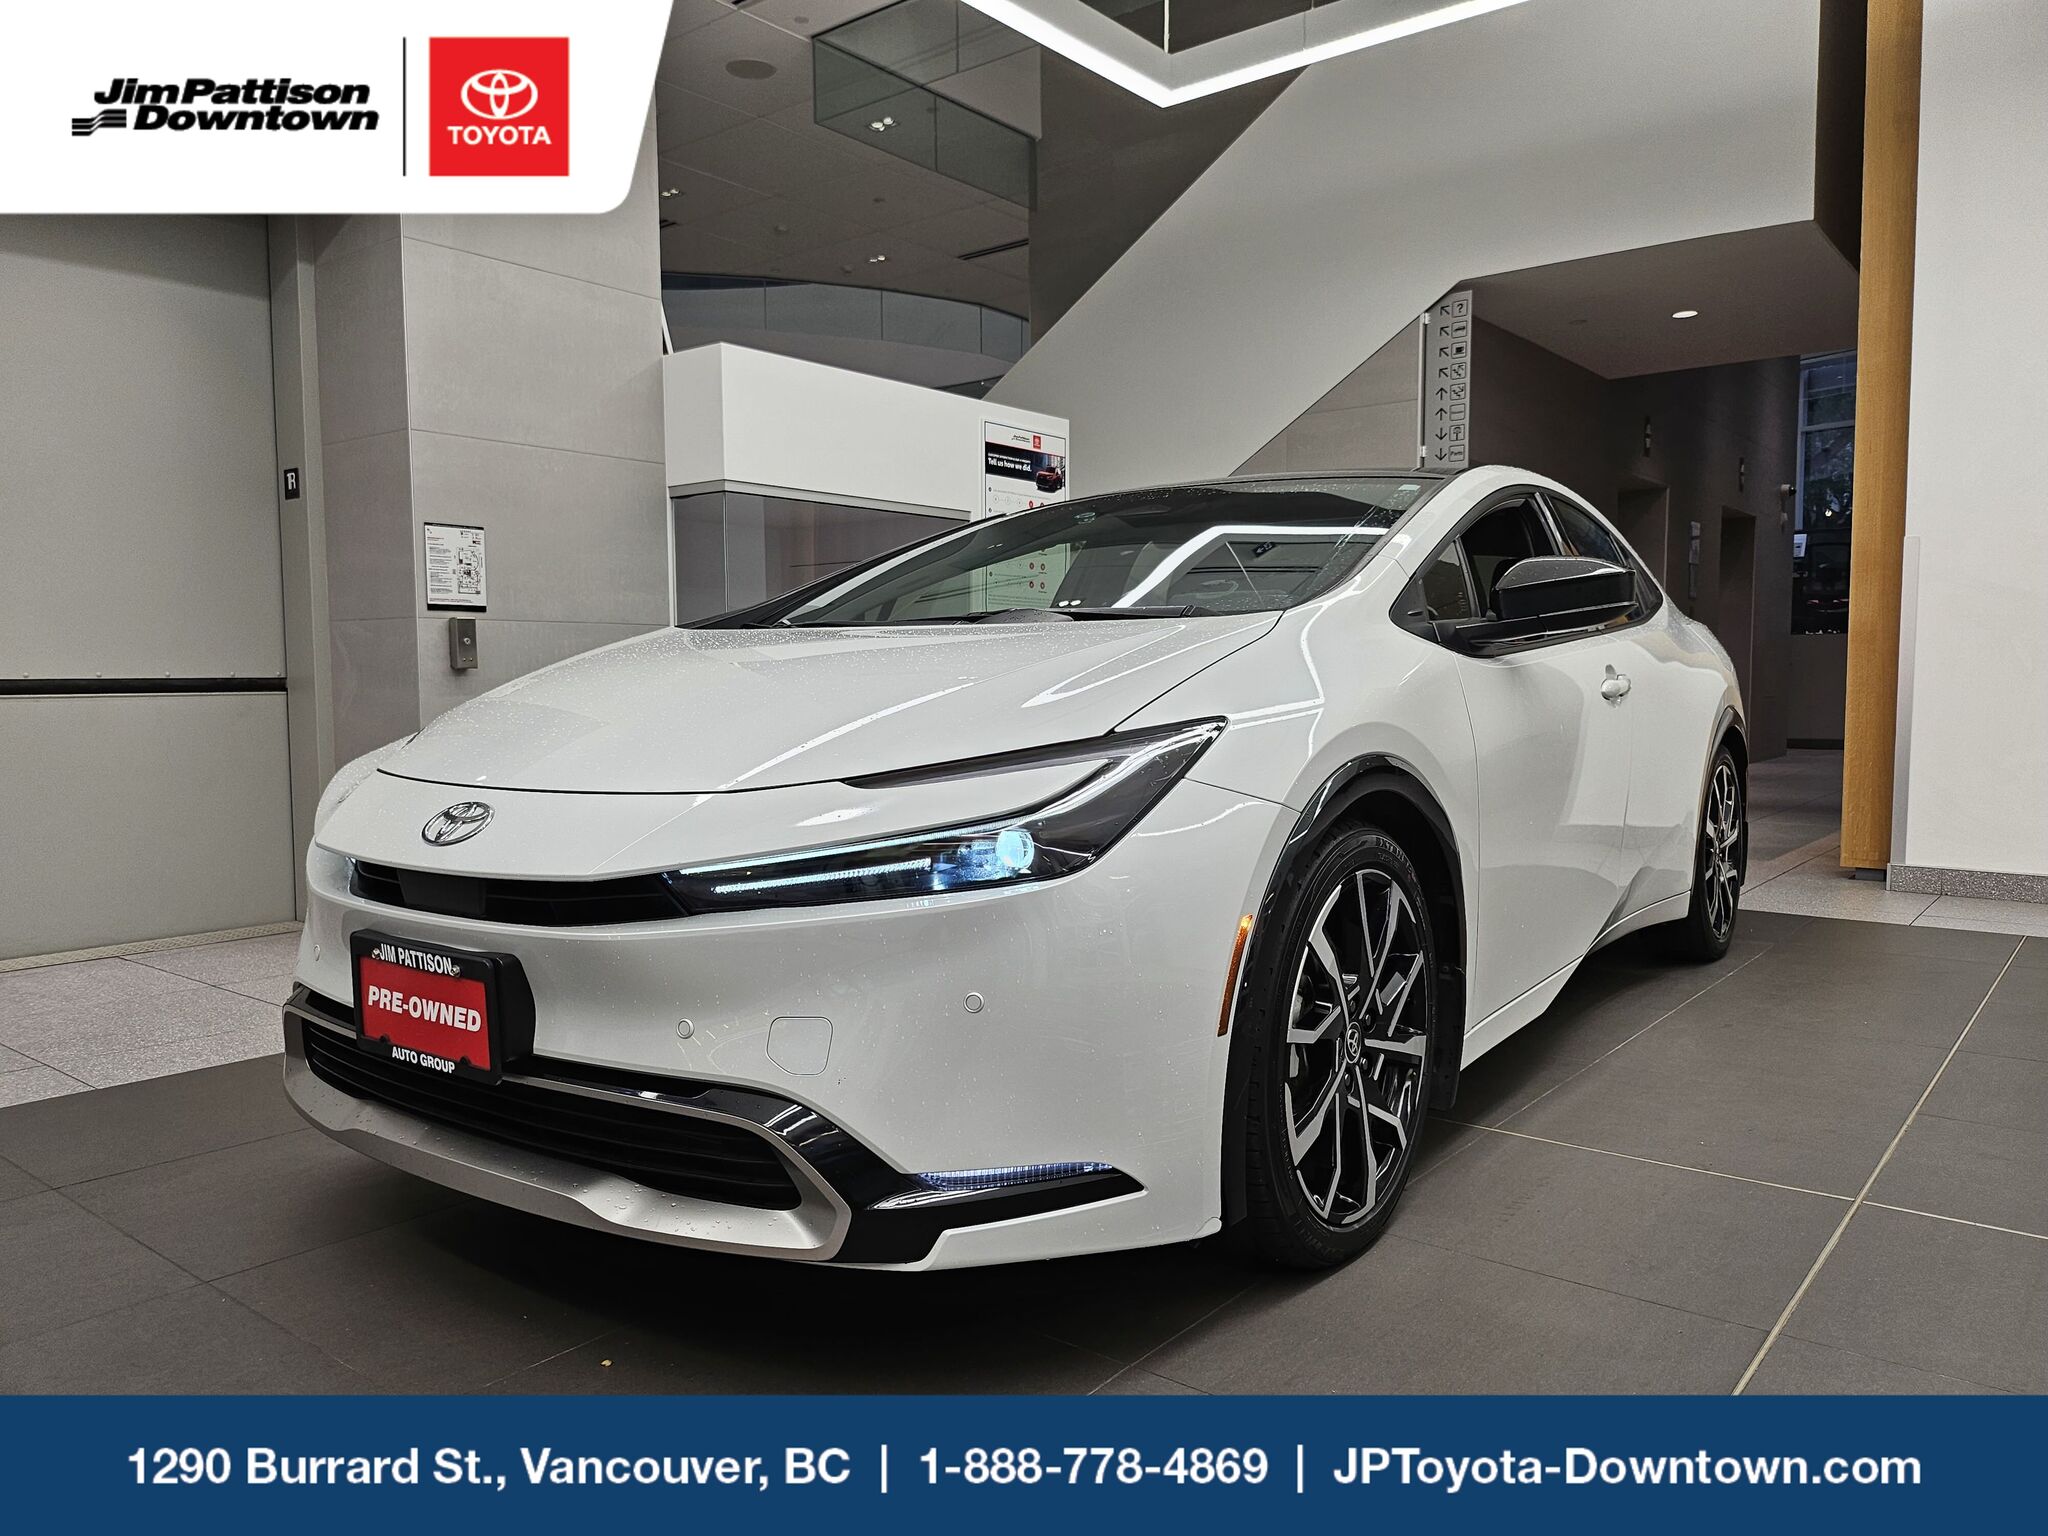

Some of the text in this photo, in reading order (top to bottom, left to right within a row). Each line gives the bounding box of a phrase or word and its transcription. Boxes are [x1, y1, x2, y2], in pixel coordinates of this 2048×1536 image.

[988, 457, 998, 466] Tell
[1004, 461, 1015, 469] how
[379, 943, 454, 977] JIM PATTISON
[368, 985, 482, 1032] PRE-OWNED
[391, 1046, 456, 1074] AUTO GROUP
